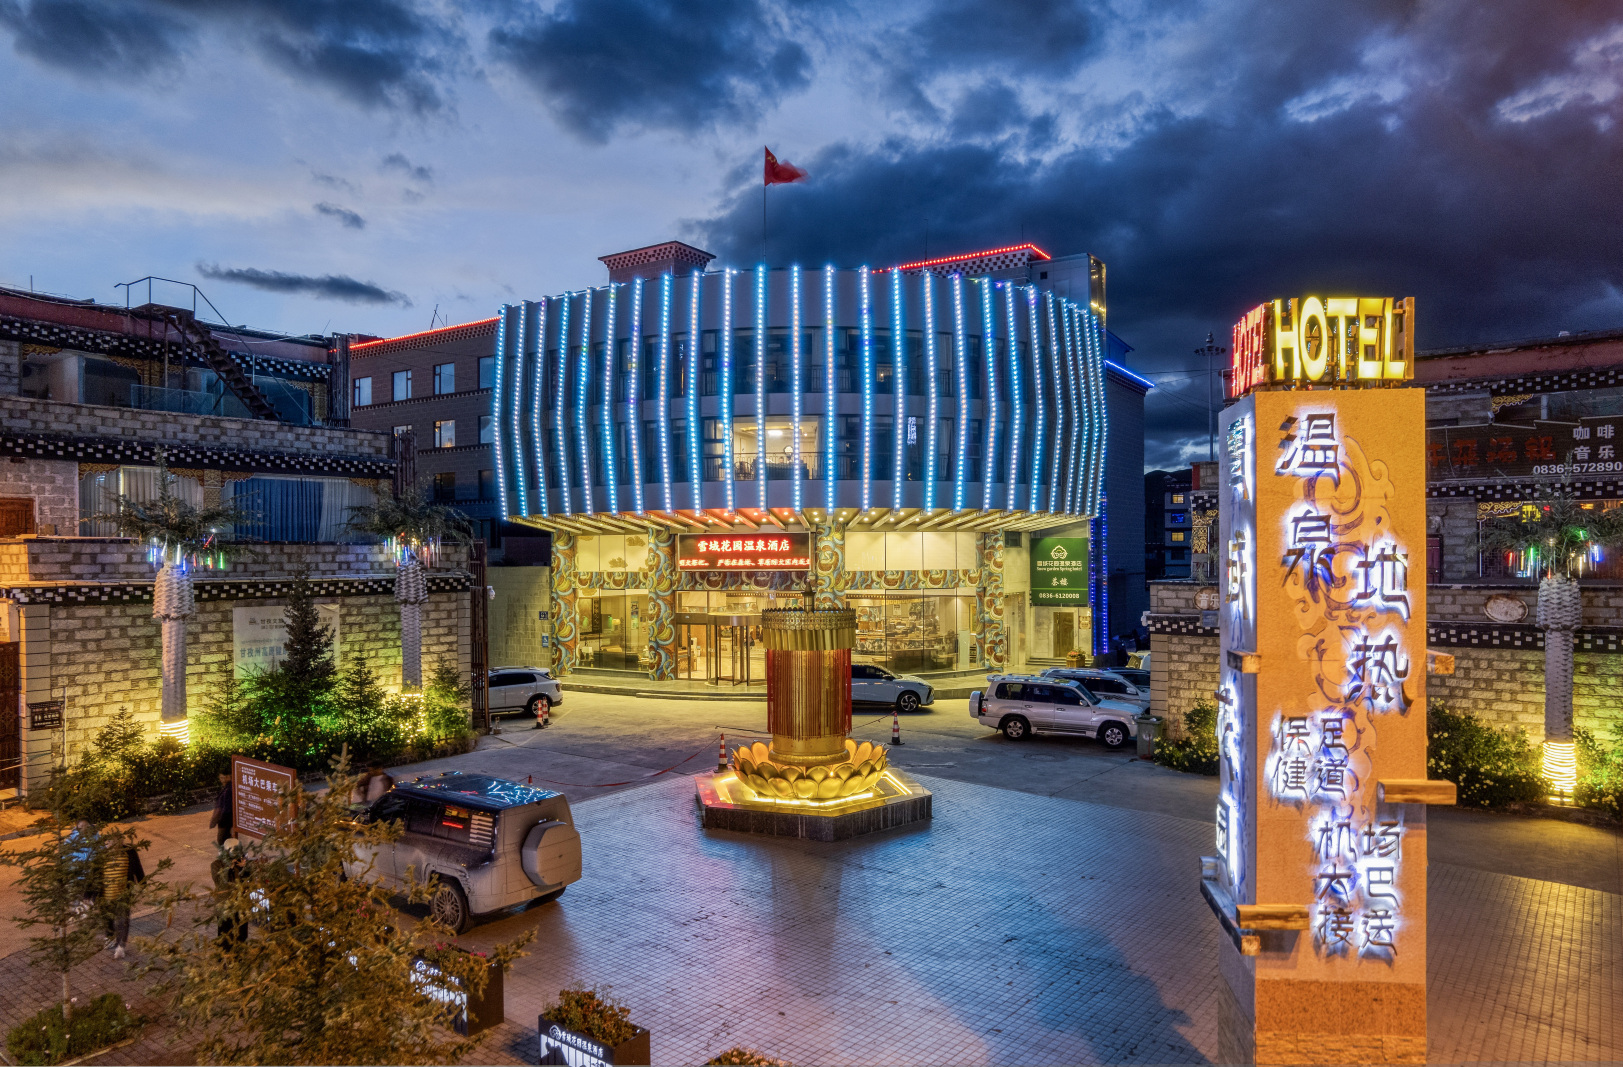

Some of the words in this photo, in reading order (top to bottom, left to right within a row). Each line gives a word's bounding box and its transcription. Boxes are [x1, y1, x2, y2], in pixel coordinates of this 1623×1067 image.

[1273, 297, 1407, 380] HOTEL
[1573, 425, 1615, 440] 咖啡
[1574, 445, 1615, 460] 音乐
[1275, 412, 1341, 588] 温泉
[1199, 593, 1220, 609] 音乐
[1348, 543, 1414, 715] 地热
[242, 774, 283, 794] 机场大巴乘车
[1273, 715, 1312, 799] 保健
[1314, 716, 1348, 800] 足道
